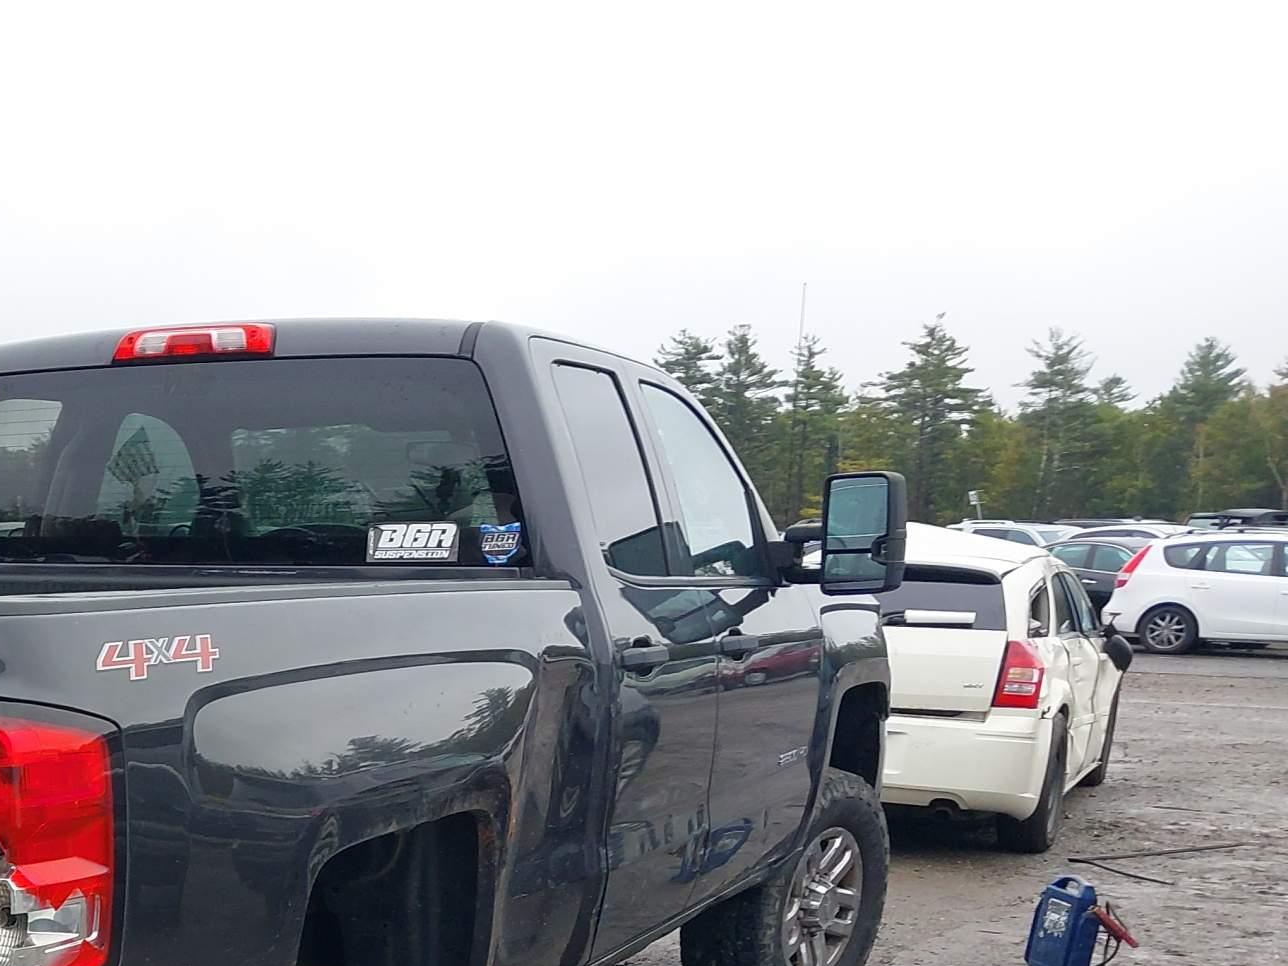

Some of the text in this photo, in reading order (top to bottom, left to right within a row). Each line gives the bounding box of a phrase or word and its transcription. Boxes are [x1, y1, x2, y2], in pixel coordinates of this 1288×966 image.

[374, 523, 458, 548] BGR
[485, 533, 517, 543] BGR
[373, 549, 451, 559] SUSPENSION
